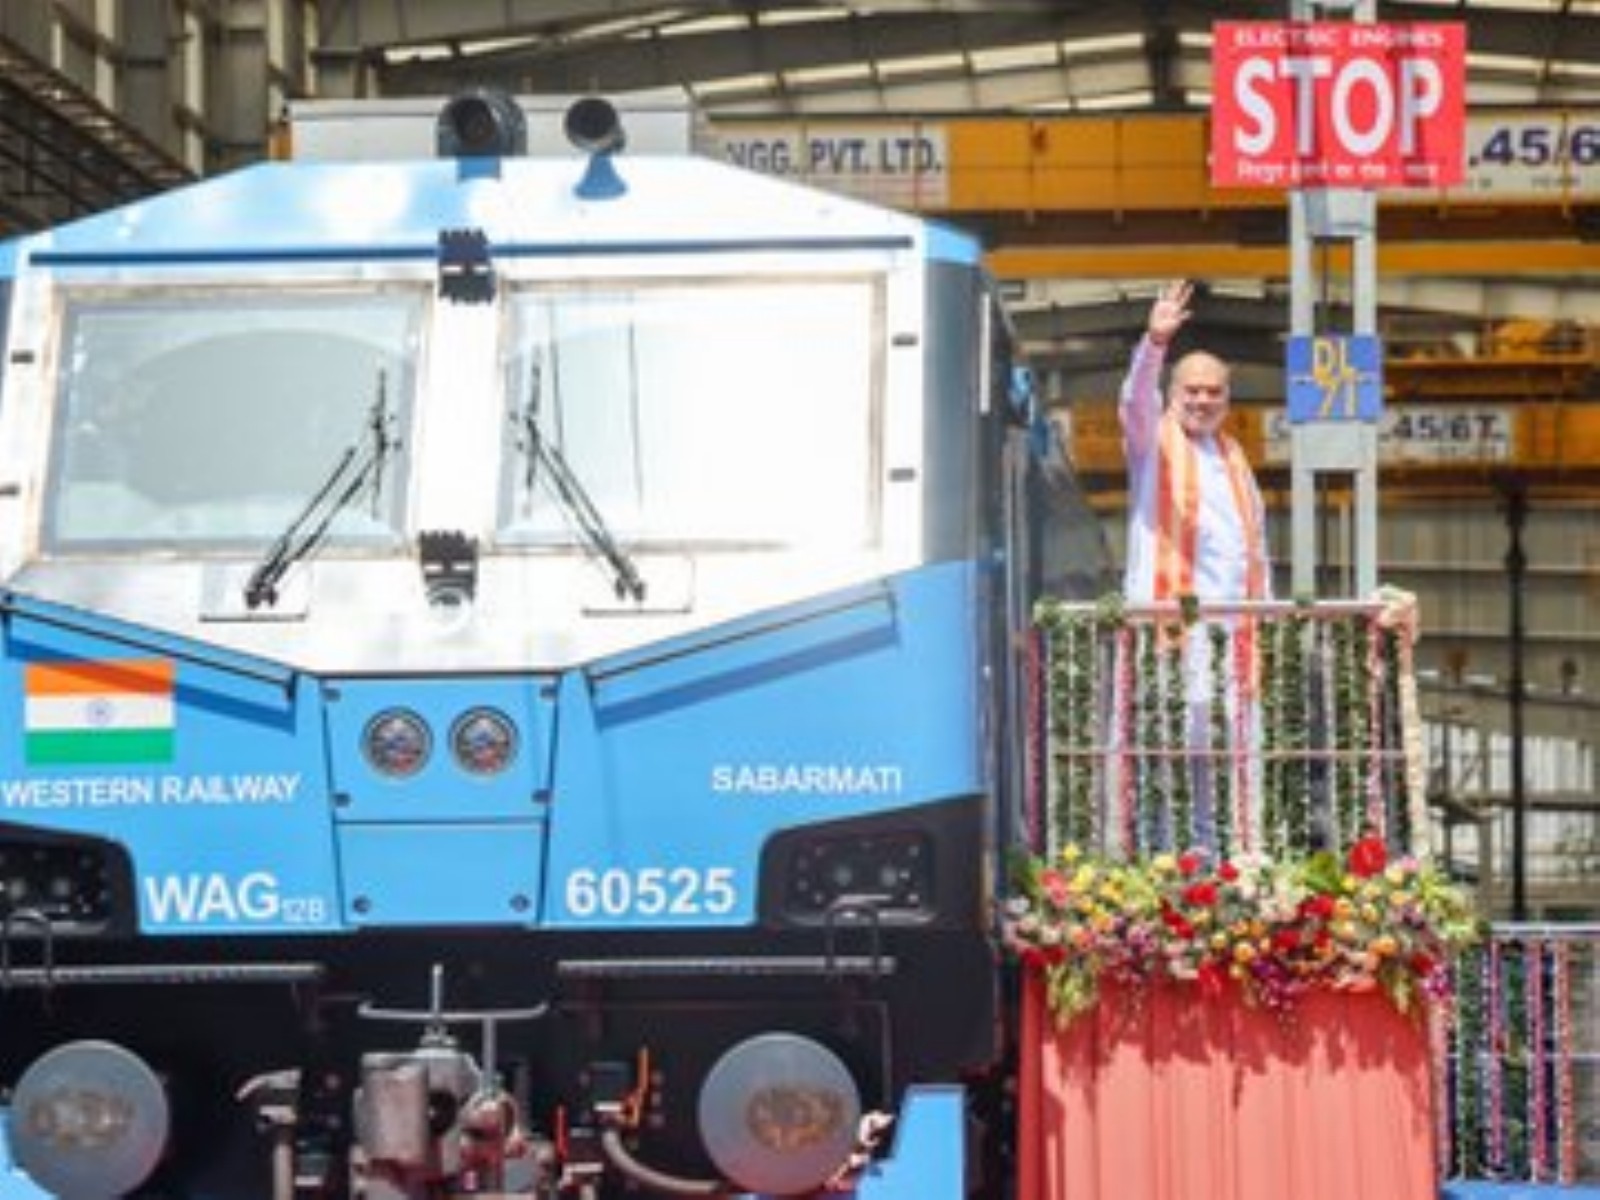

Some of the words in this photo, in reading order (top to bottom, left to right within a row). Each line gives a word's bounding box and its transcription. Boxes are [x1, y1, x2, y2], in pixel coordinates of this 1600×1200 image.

[1234, 27, 1338, 47] ELECTRIC
[1349, 27, 1444, 47] ENGINES
[1233, 57, 1443, 157] STOP
[809, 138, 870, 174] PVT.
[878, 136, 942, 174] LTD.
[1, 777, 151, 807] WESTERN
[161, 772, 301, 802] RAILWAY
[711, 765, 903, 793] SABARMATI
[565, 867, 736, 917] 60525
